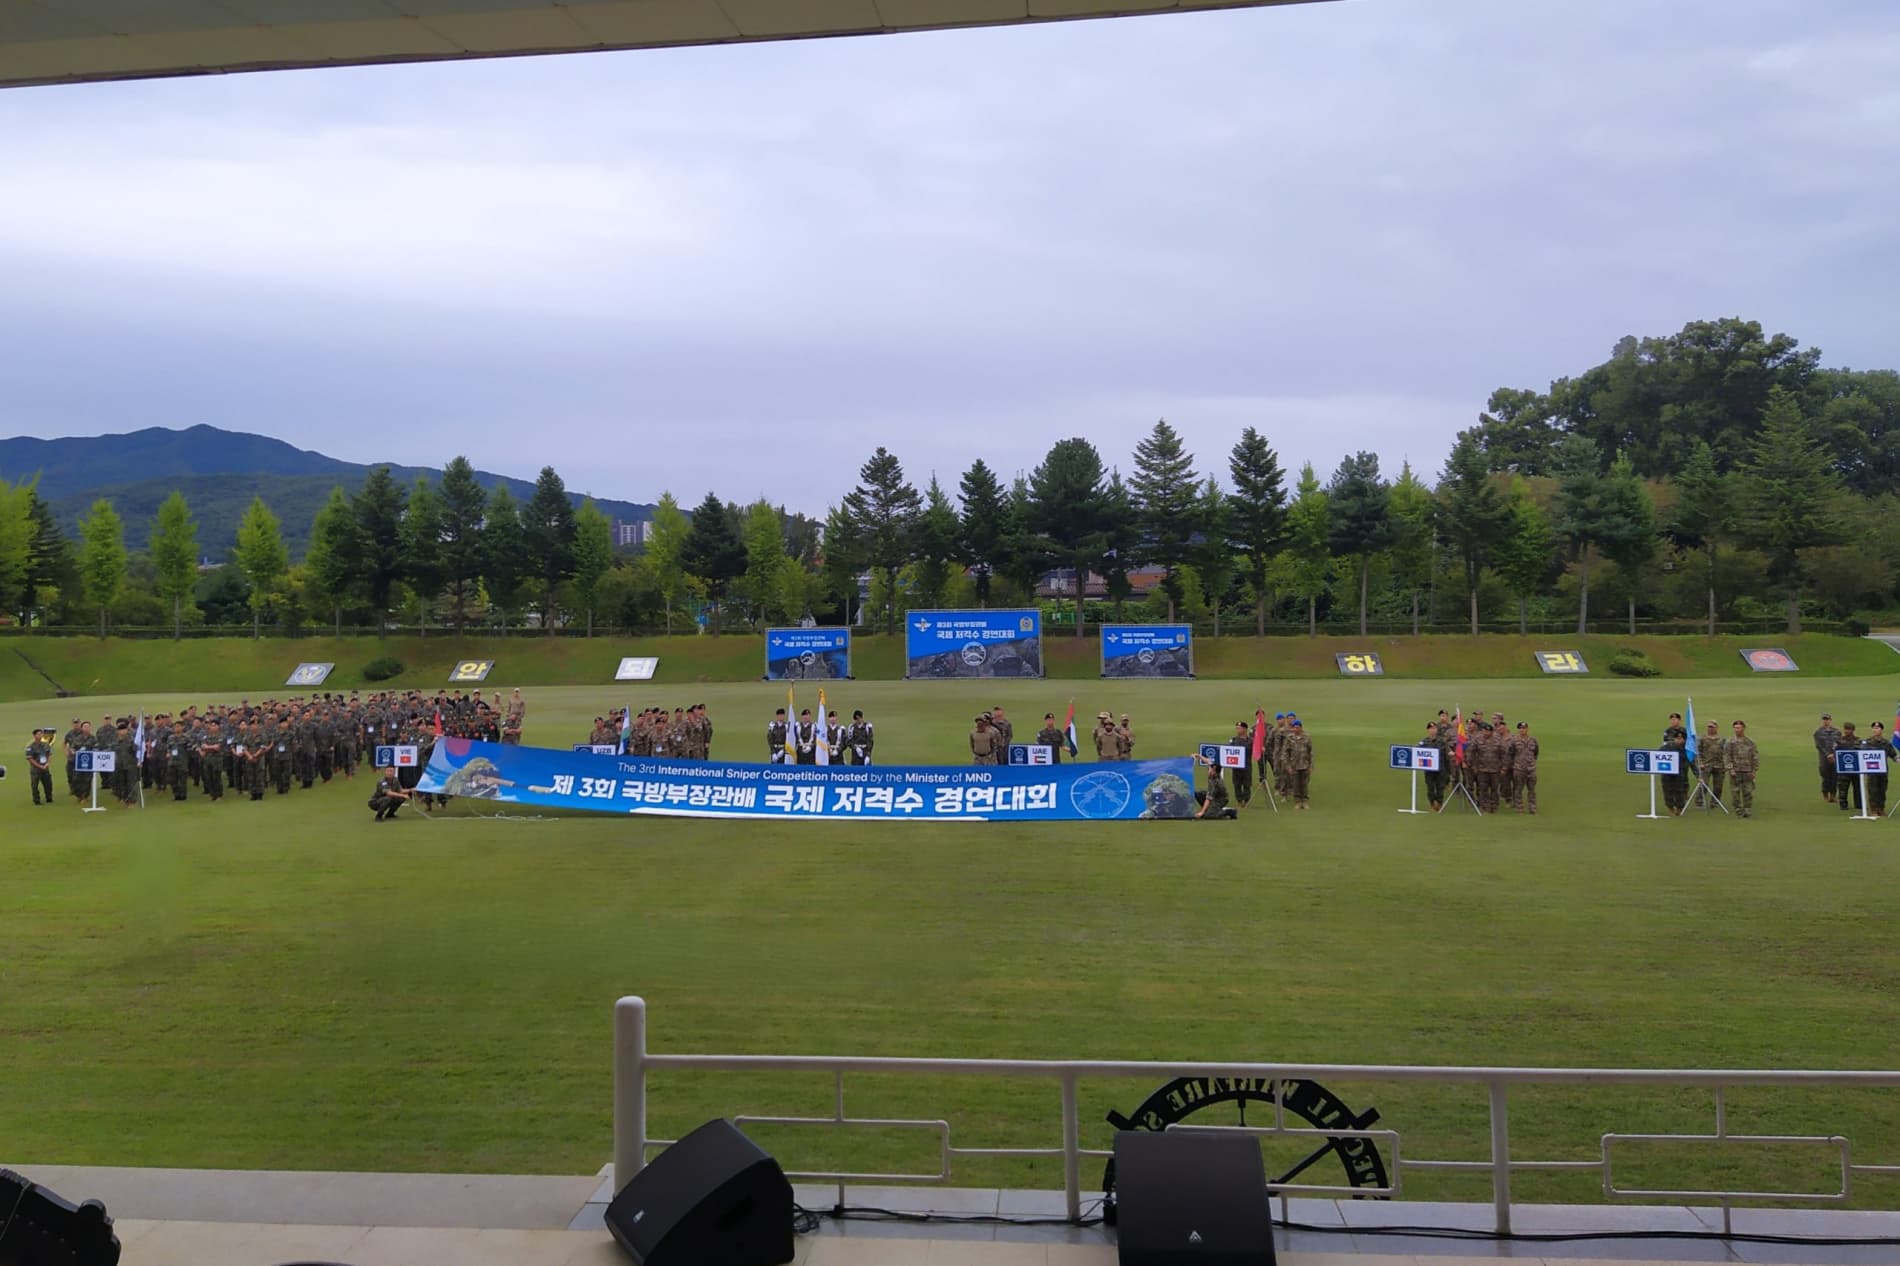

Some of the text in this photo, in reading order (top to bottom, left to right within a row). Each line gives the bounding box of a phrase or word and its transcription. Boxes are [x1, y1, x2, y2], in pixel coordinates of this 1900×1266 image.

[1343, 655, 1377, 673] 하
[1543, 653, 1579, 671] 라
[456, 662, 488, 680] 안
[1032, 747, 1048, 755] UAE
[1225, 748, 1241, 756] TUR
[1416, 750, 1433, 758] MGL
[1655, 753, 1673, 761] KAZ
[1863, 753, 1882, 761] CAM
[617, 762, 992, 785] The 3rd International Sniper Competition hosted by the Minister of MND
[549, 774, 1058, 813] 제 3회 국방부장관배 국제 저격수 경연대회
